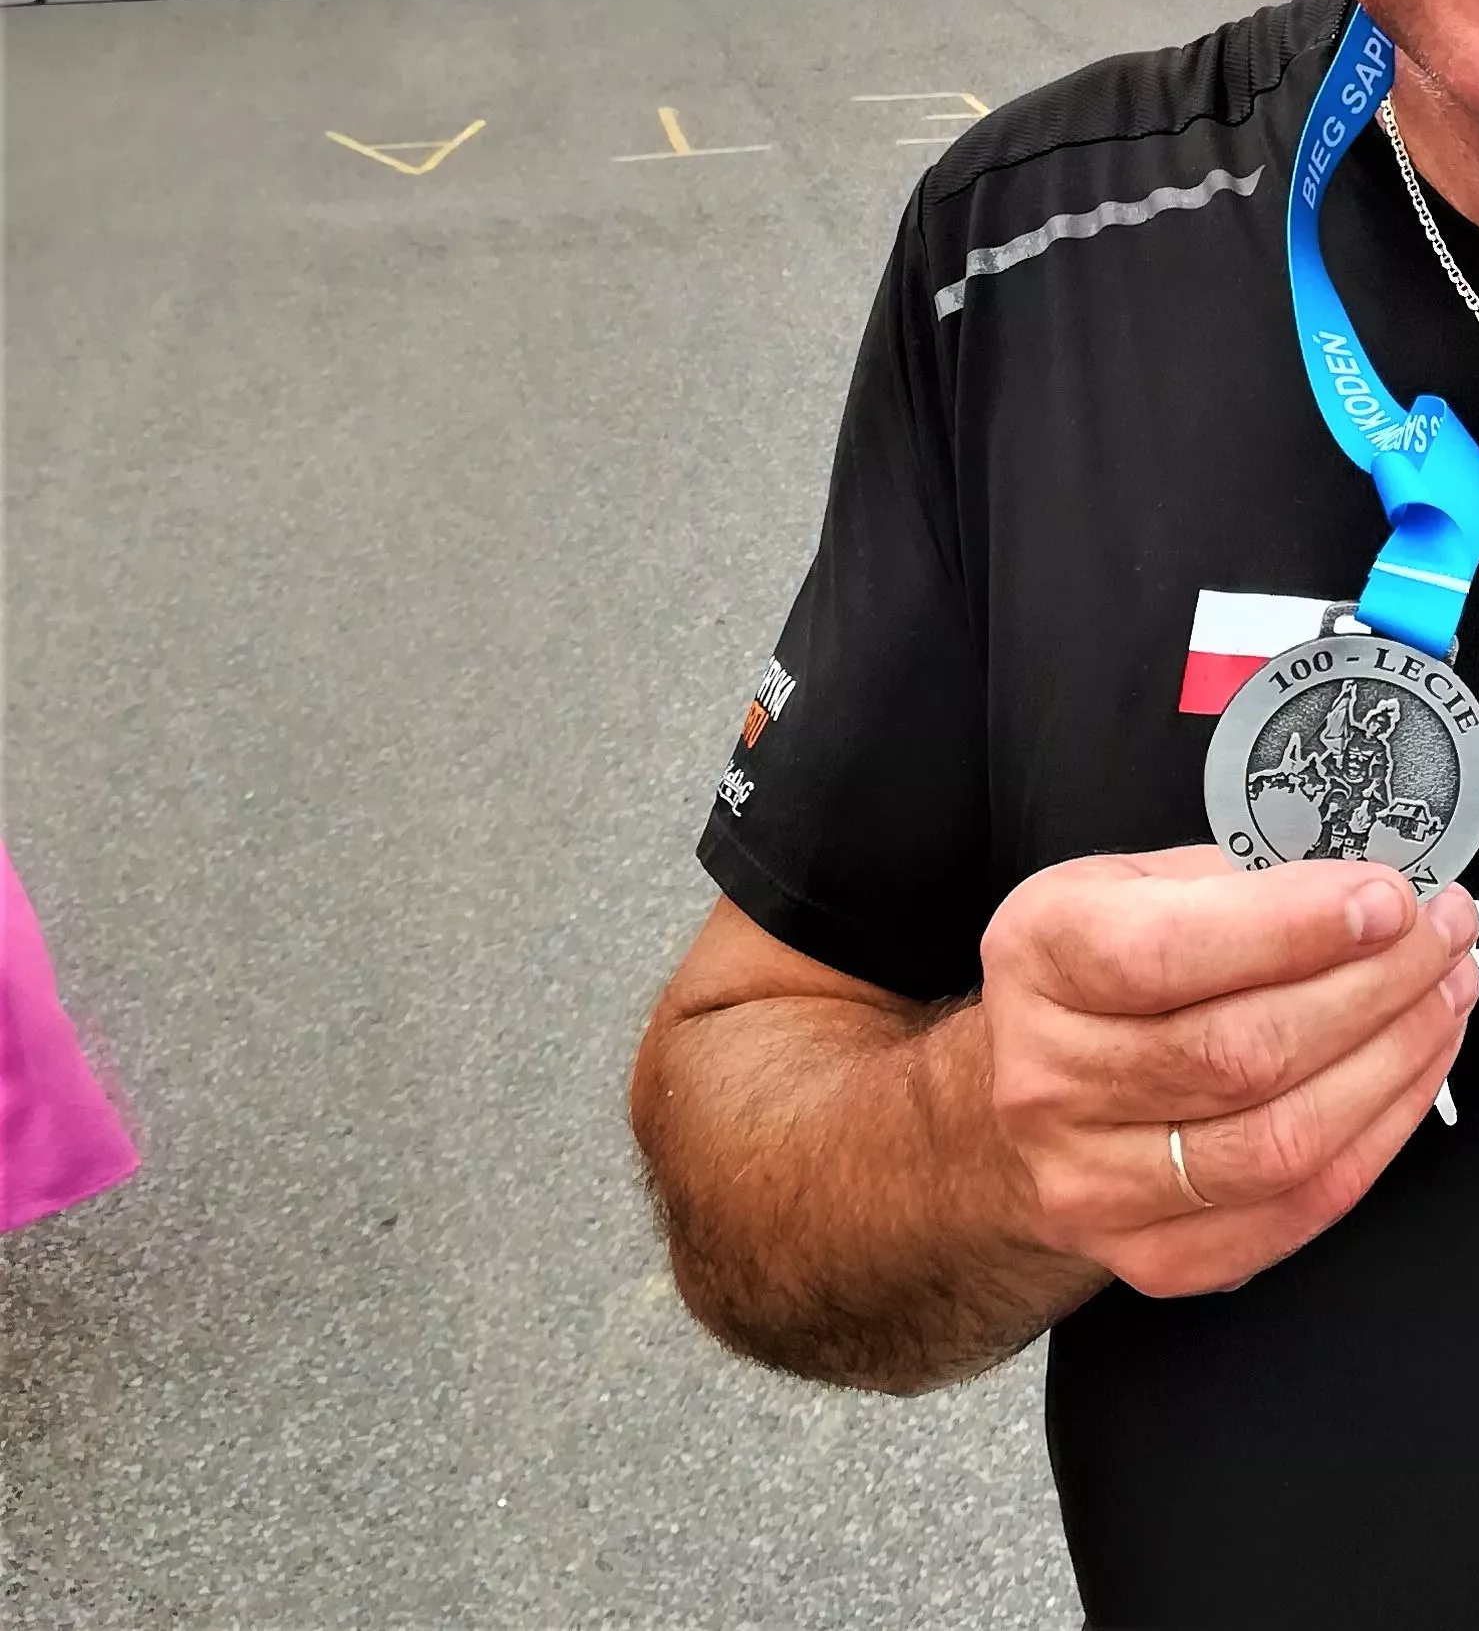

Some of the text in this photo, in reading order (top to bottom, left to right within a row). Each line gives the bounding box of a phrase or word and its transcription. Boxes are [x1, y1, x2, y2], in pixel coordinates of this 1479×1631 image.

[1301, 25, 1393, 210] BIEG SAPI
[1311, 330, 1392, 432] KODEŃ
[1268, 650, 1334, 695] 100
[1373, 646, 1479, 734] LECIE
